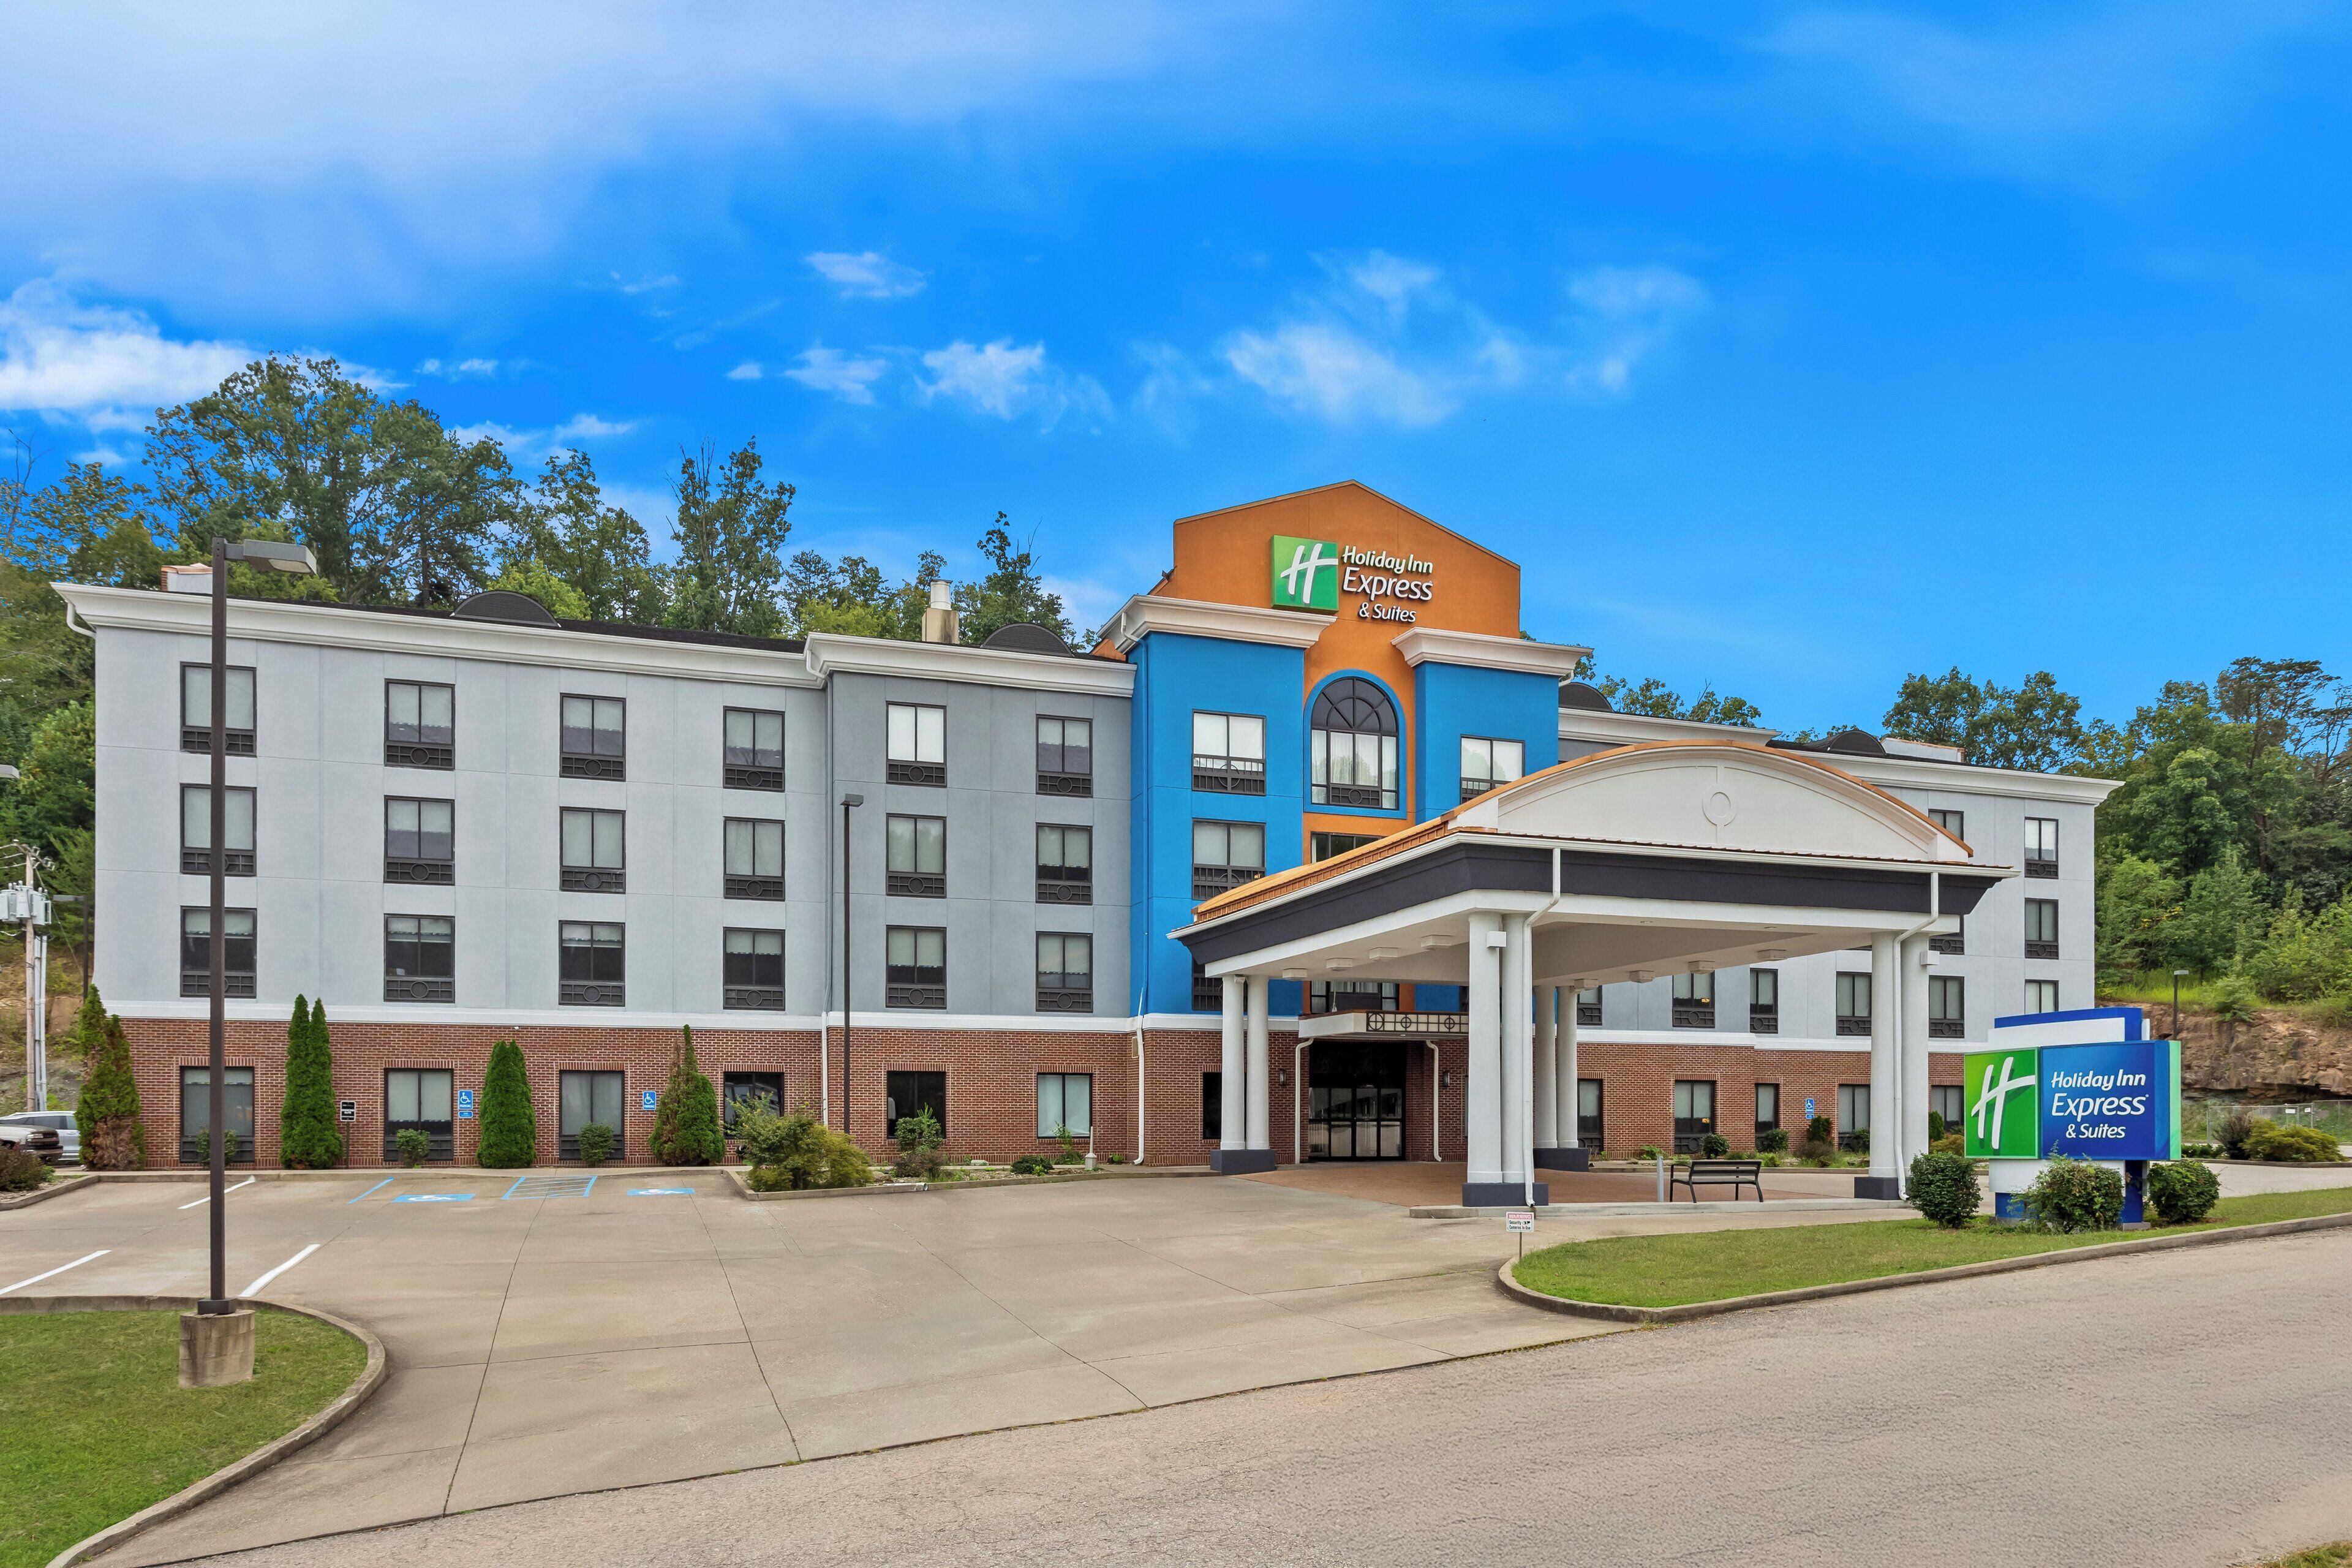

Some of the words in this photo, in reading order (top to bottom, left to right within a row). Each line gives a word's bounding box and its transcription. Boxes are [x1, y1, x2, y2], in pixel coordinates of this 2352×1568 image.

[1342, 545, 1406, 574] Holiday
[1408, 554, 1433, 574] Inn
[1343, 567, 1433, 601] Express
[1359, 602, 1370, 618] &
[1373, 603, 1416, 622] Suites
[2051, 1071, 2116, 1090] Holiday
[2117, 1069, 2146, 1086] Inn
[2051, 1093, 2146, 1122] Express
[2065, 1124, 2076, 1138] &
[2079, 1123, 2126, 1139] Suites
